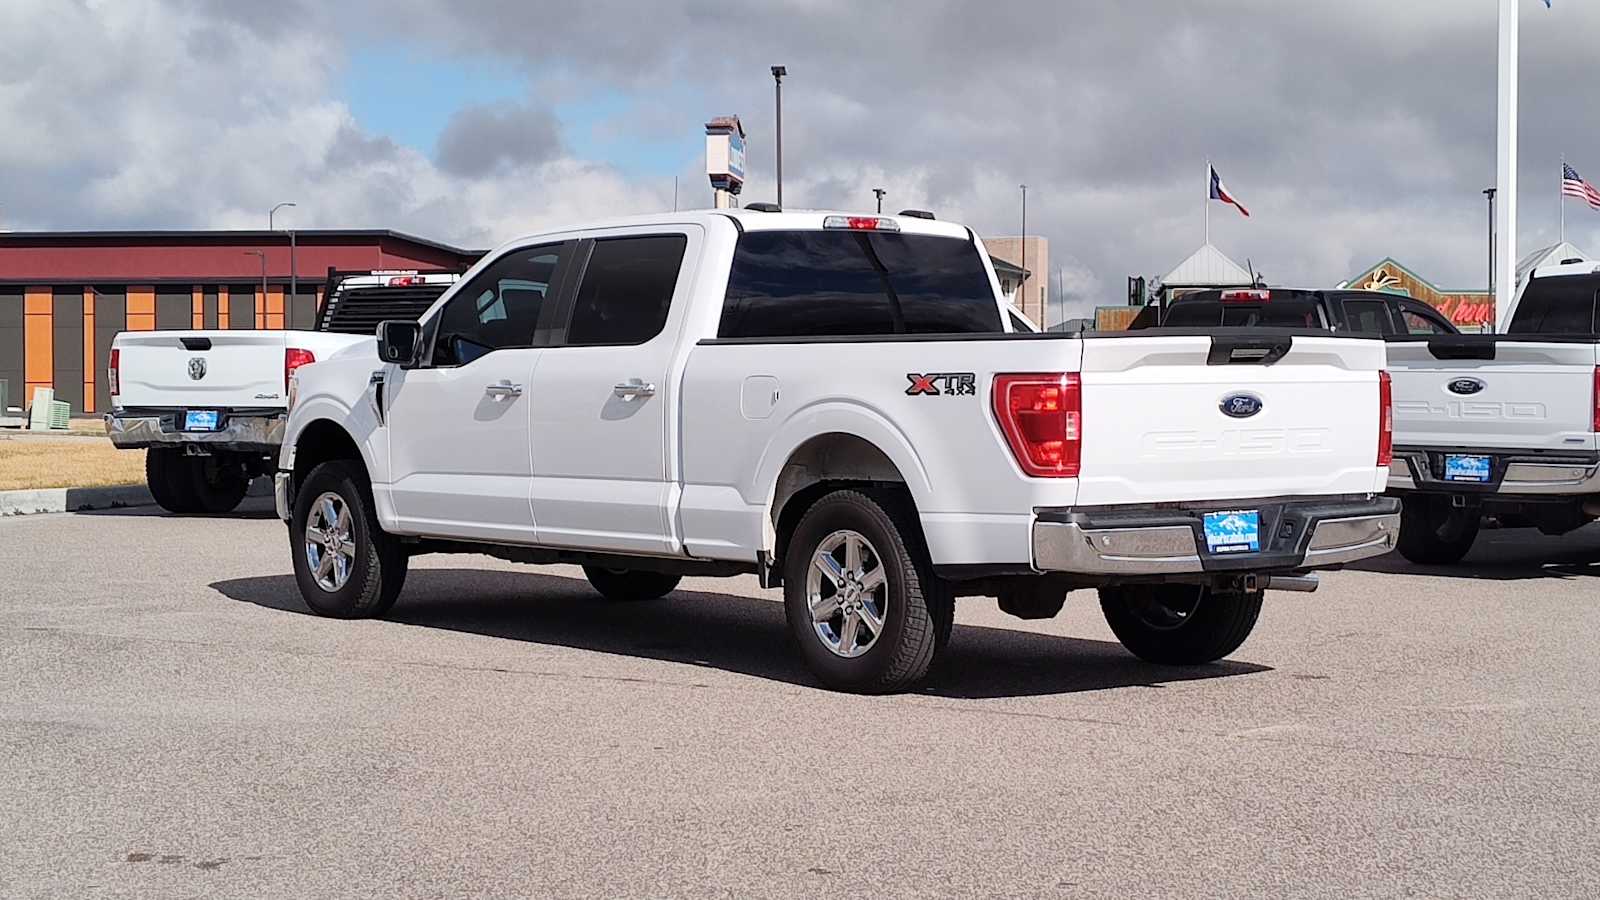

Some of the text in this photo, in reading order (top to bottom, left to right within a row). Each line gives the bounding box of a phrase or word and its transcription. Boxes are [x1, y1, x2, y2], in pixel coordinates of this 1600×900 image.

[905, 373, 975, 395] XTR
[944, 387, 975, 396] 4x4
[1230, 397, 1255, 413] Ford
[1137, 427, 1336, 458] F-150
